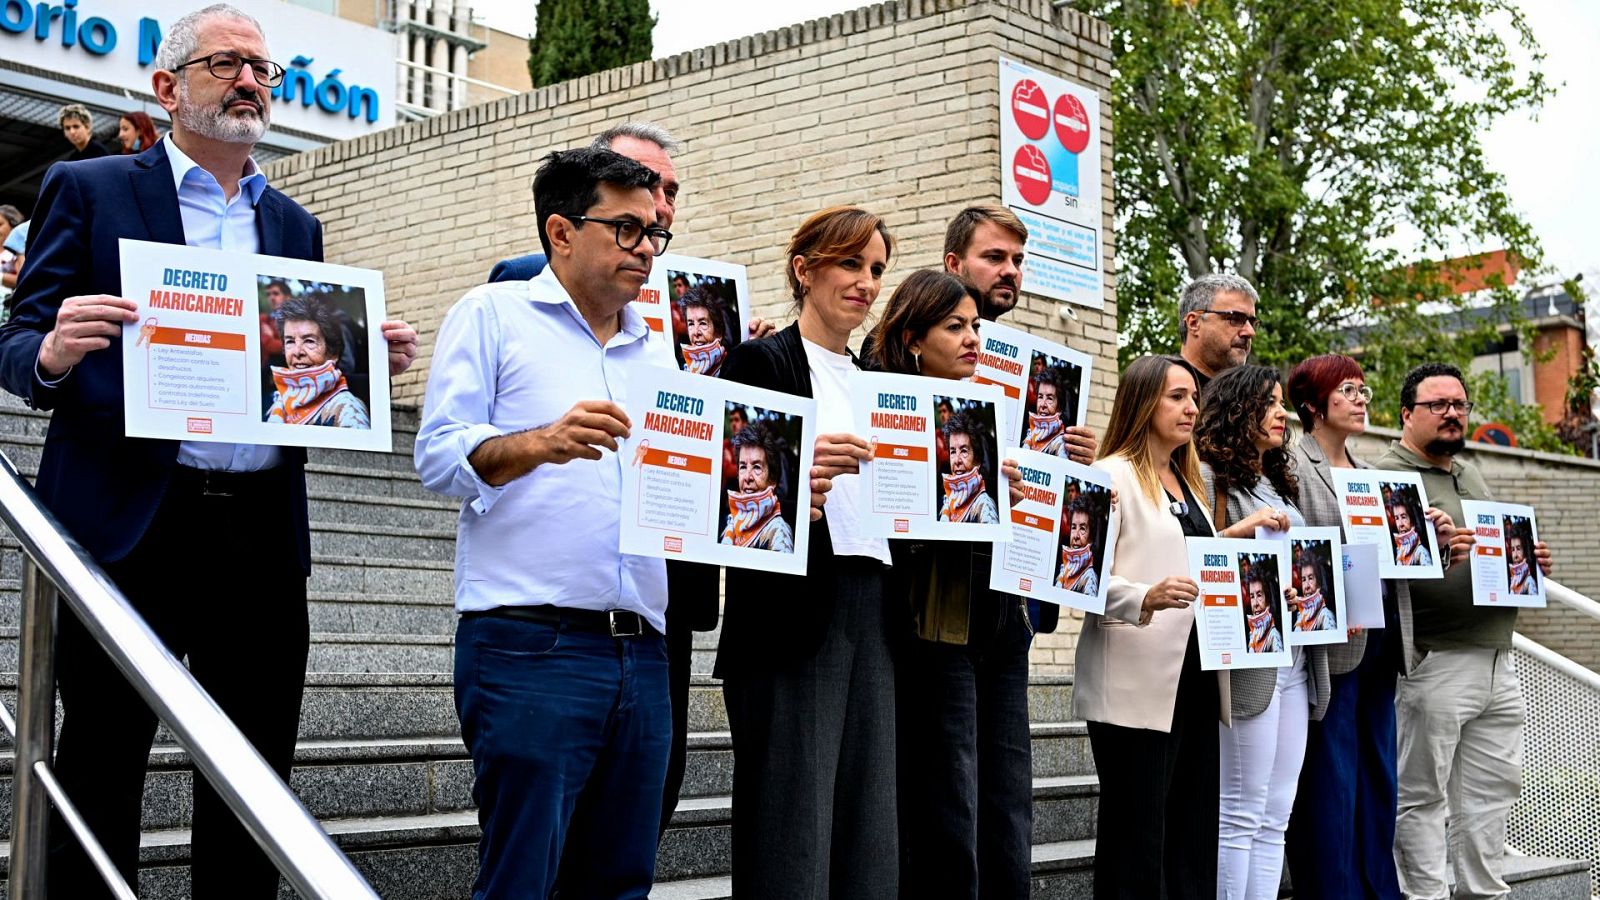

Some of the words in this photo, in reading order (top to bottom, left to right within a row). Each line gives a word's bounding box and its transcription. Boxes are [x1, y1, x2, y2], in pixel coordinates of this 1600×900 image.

[163, 268, 228, 292] DECRETO
[149, 290, 244, 317] MARICARMEN
[985, 338, 1019, 359] DECRETO
[978, 352, 1024, 377] MARICARMEN
[656, 390, 704, 417] DECRETO
[878, 393, 917, 411] DECRETO
[645, 412, 713, 441] MARICARMEN
[871, 413, 927, 433] MARICARMEN
[1204, 554, 1228, 567] DECRETO
[1200, 570, 1235, 583] MARICARMEN
